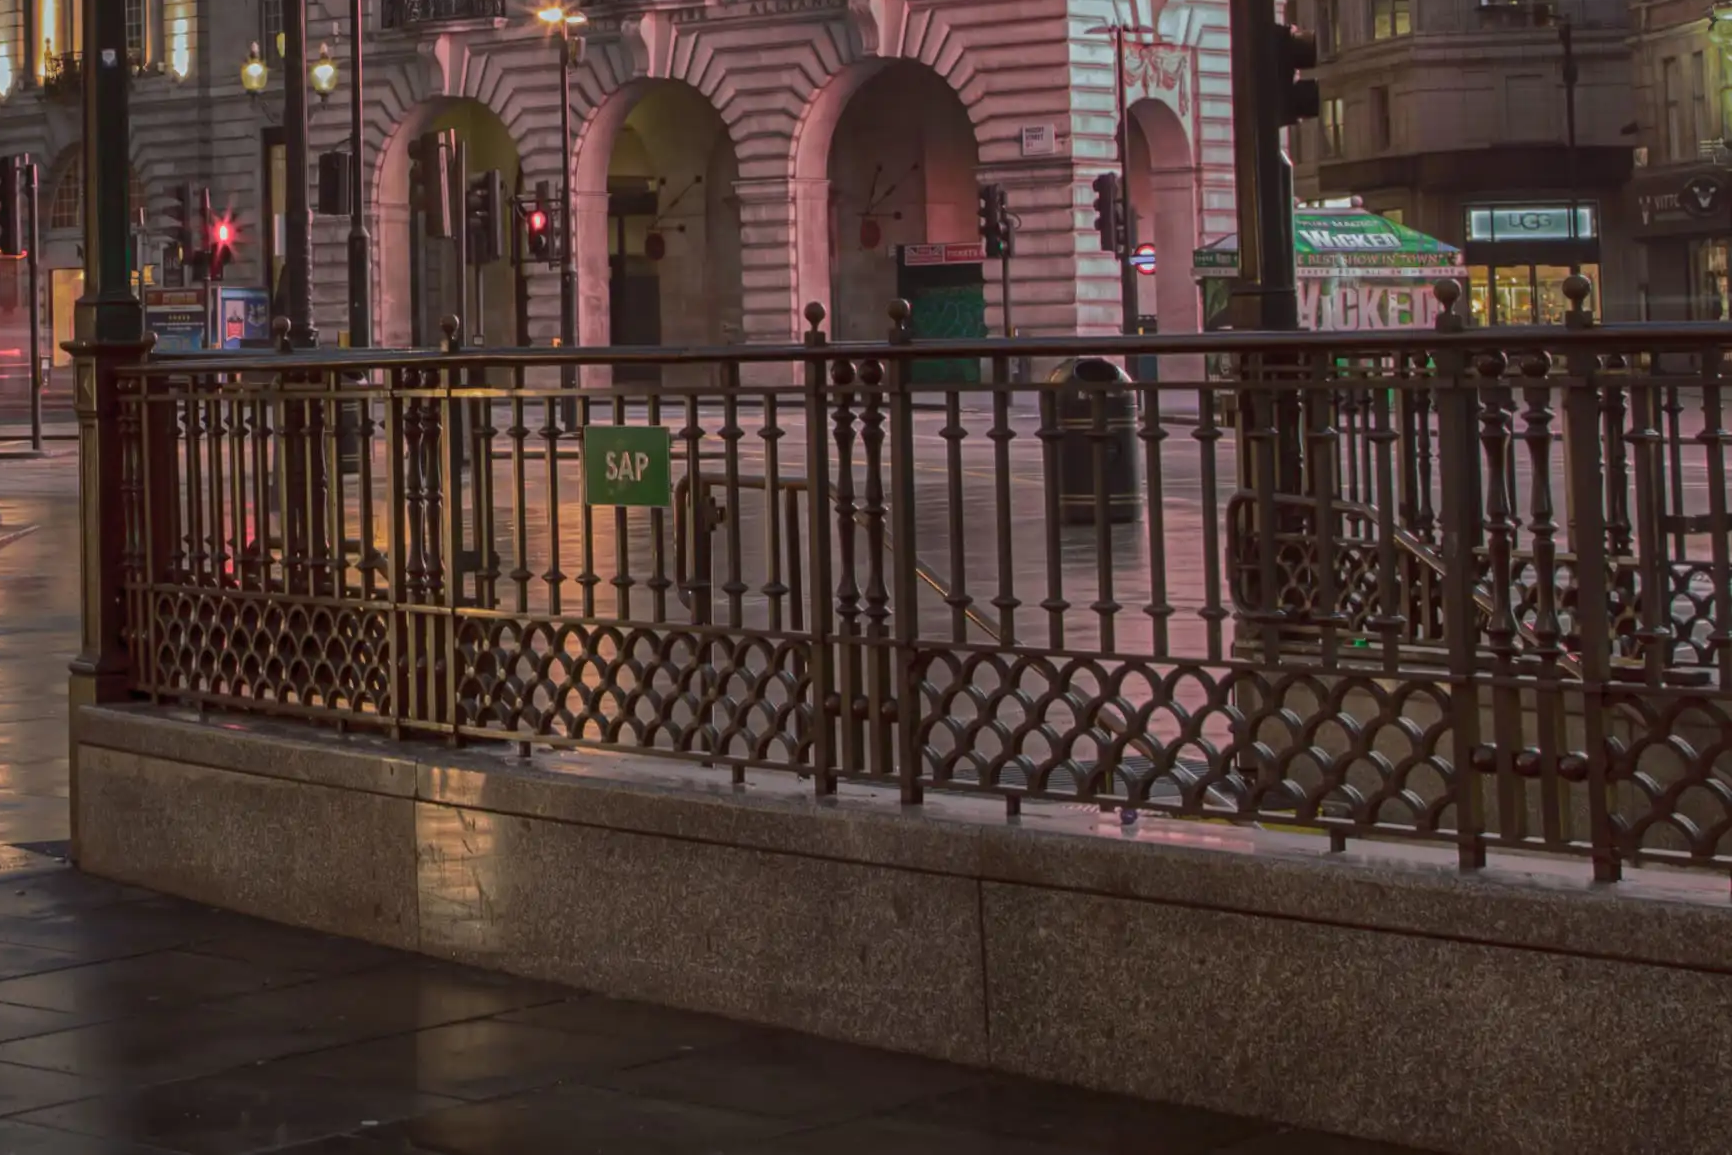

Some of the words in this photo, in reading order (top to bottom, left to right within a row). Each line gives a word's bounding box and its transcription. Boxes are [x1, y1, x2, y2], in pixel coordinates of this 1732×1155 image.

[1508, 212, 1552, 230] UGG
[1298, 229, 1402, 248] WICKED
[1309, 254, 1337, 266] BEST
[1343, 253, 1379, 266] SHOW
[605, 450, 649, 482] SAP
